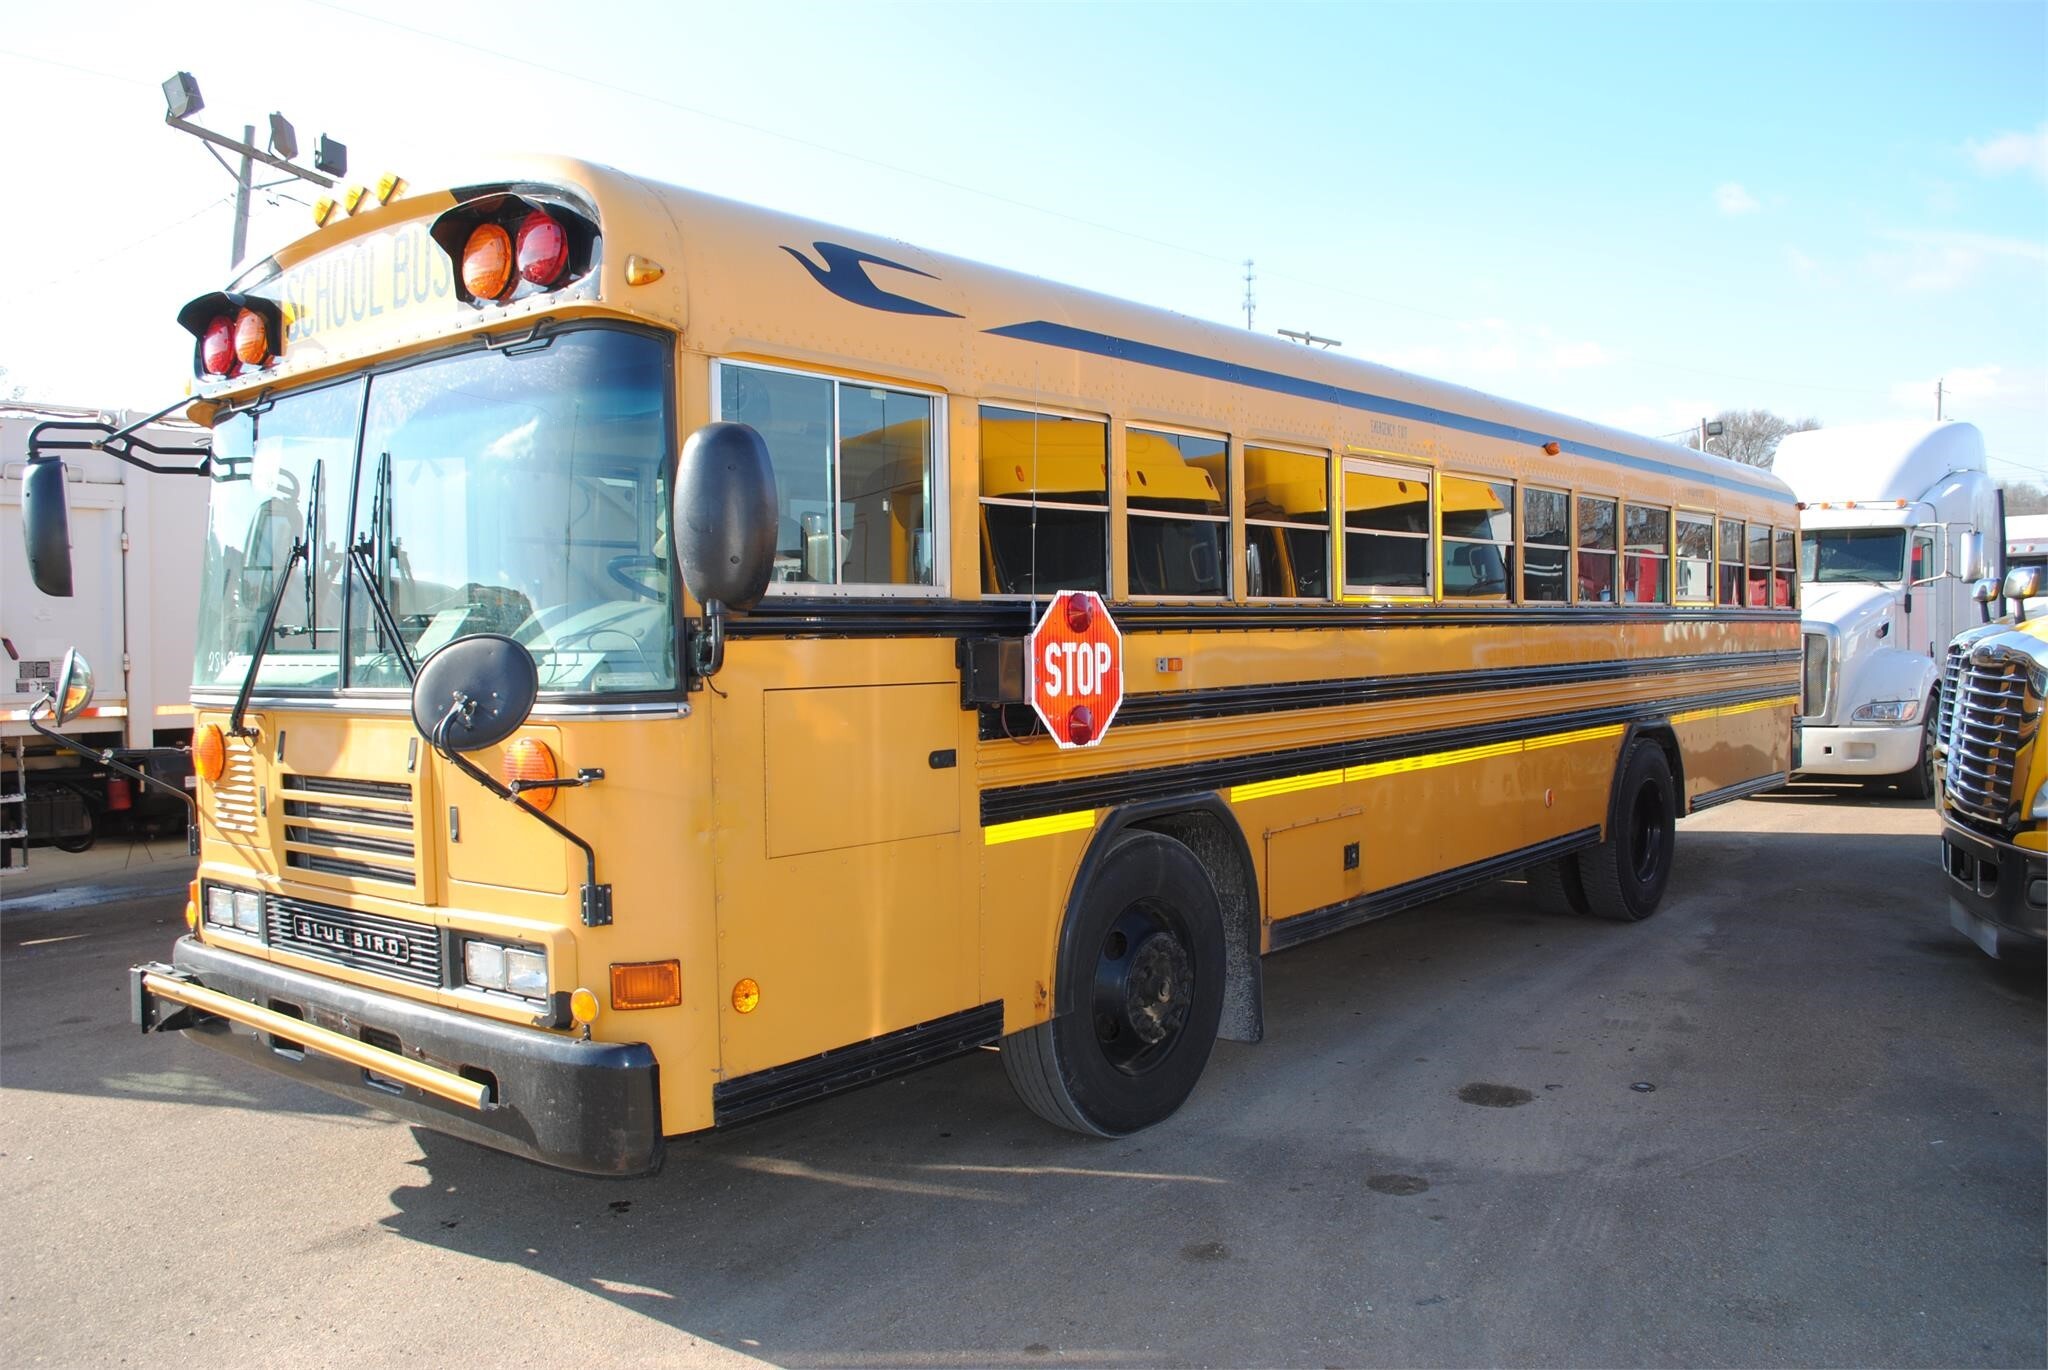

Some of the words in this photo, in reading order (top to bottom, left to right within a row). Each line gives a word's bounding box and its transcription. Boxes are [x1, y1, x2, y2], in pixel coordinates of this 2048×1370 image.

[286, 245, 383, 342] SCHOOL
[394, 223, 451, 309] BUS
[1045, 642, 1111, 697] STOP
[301, 921, 345, 943] BLUE
[353, 932, 399, 955] BIRD
